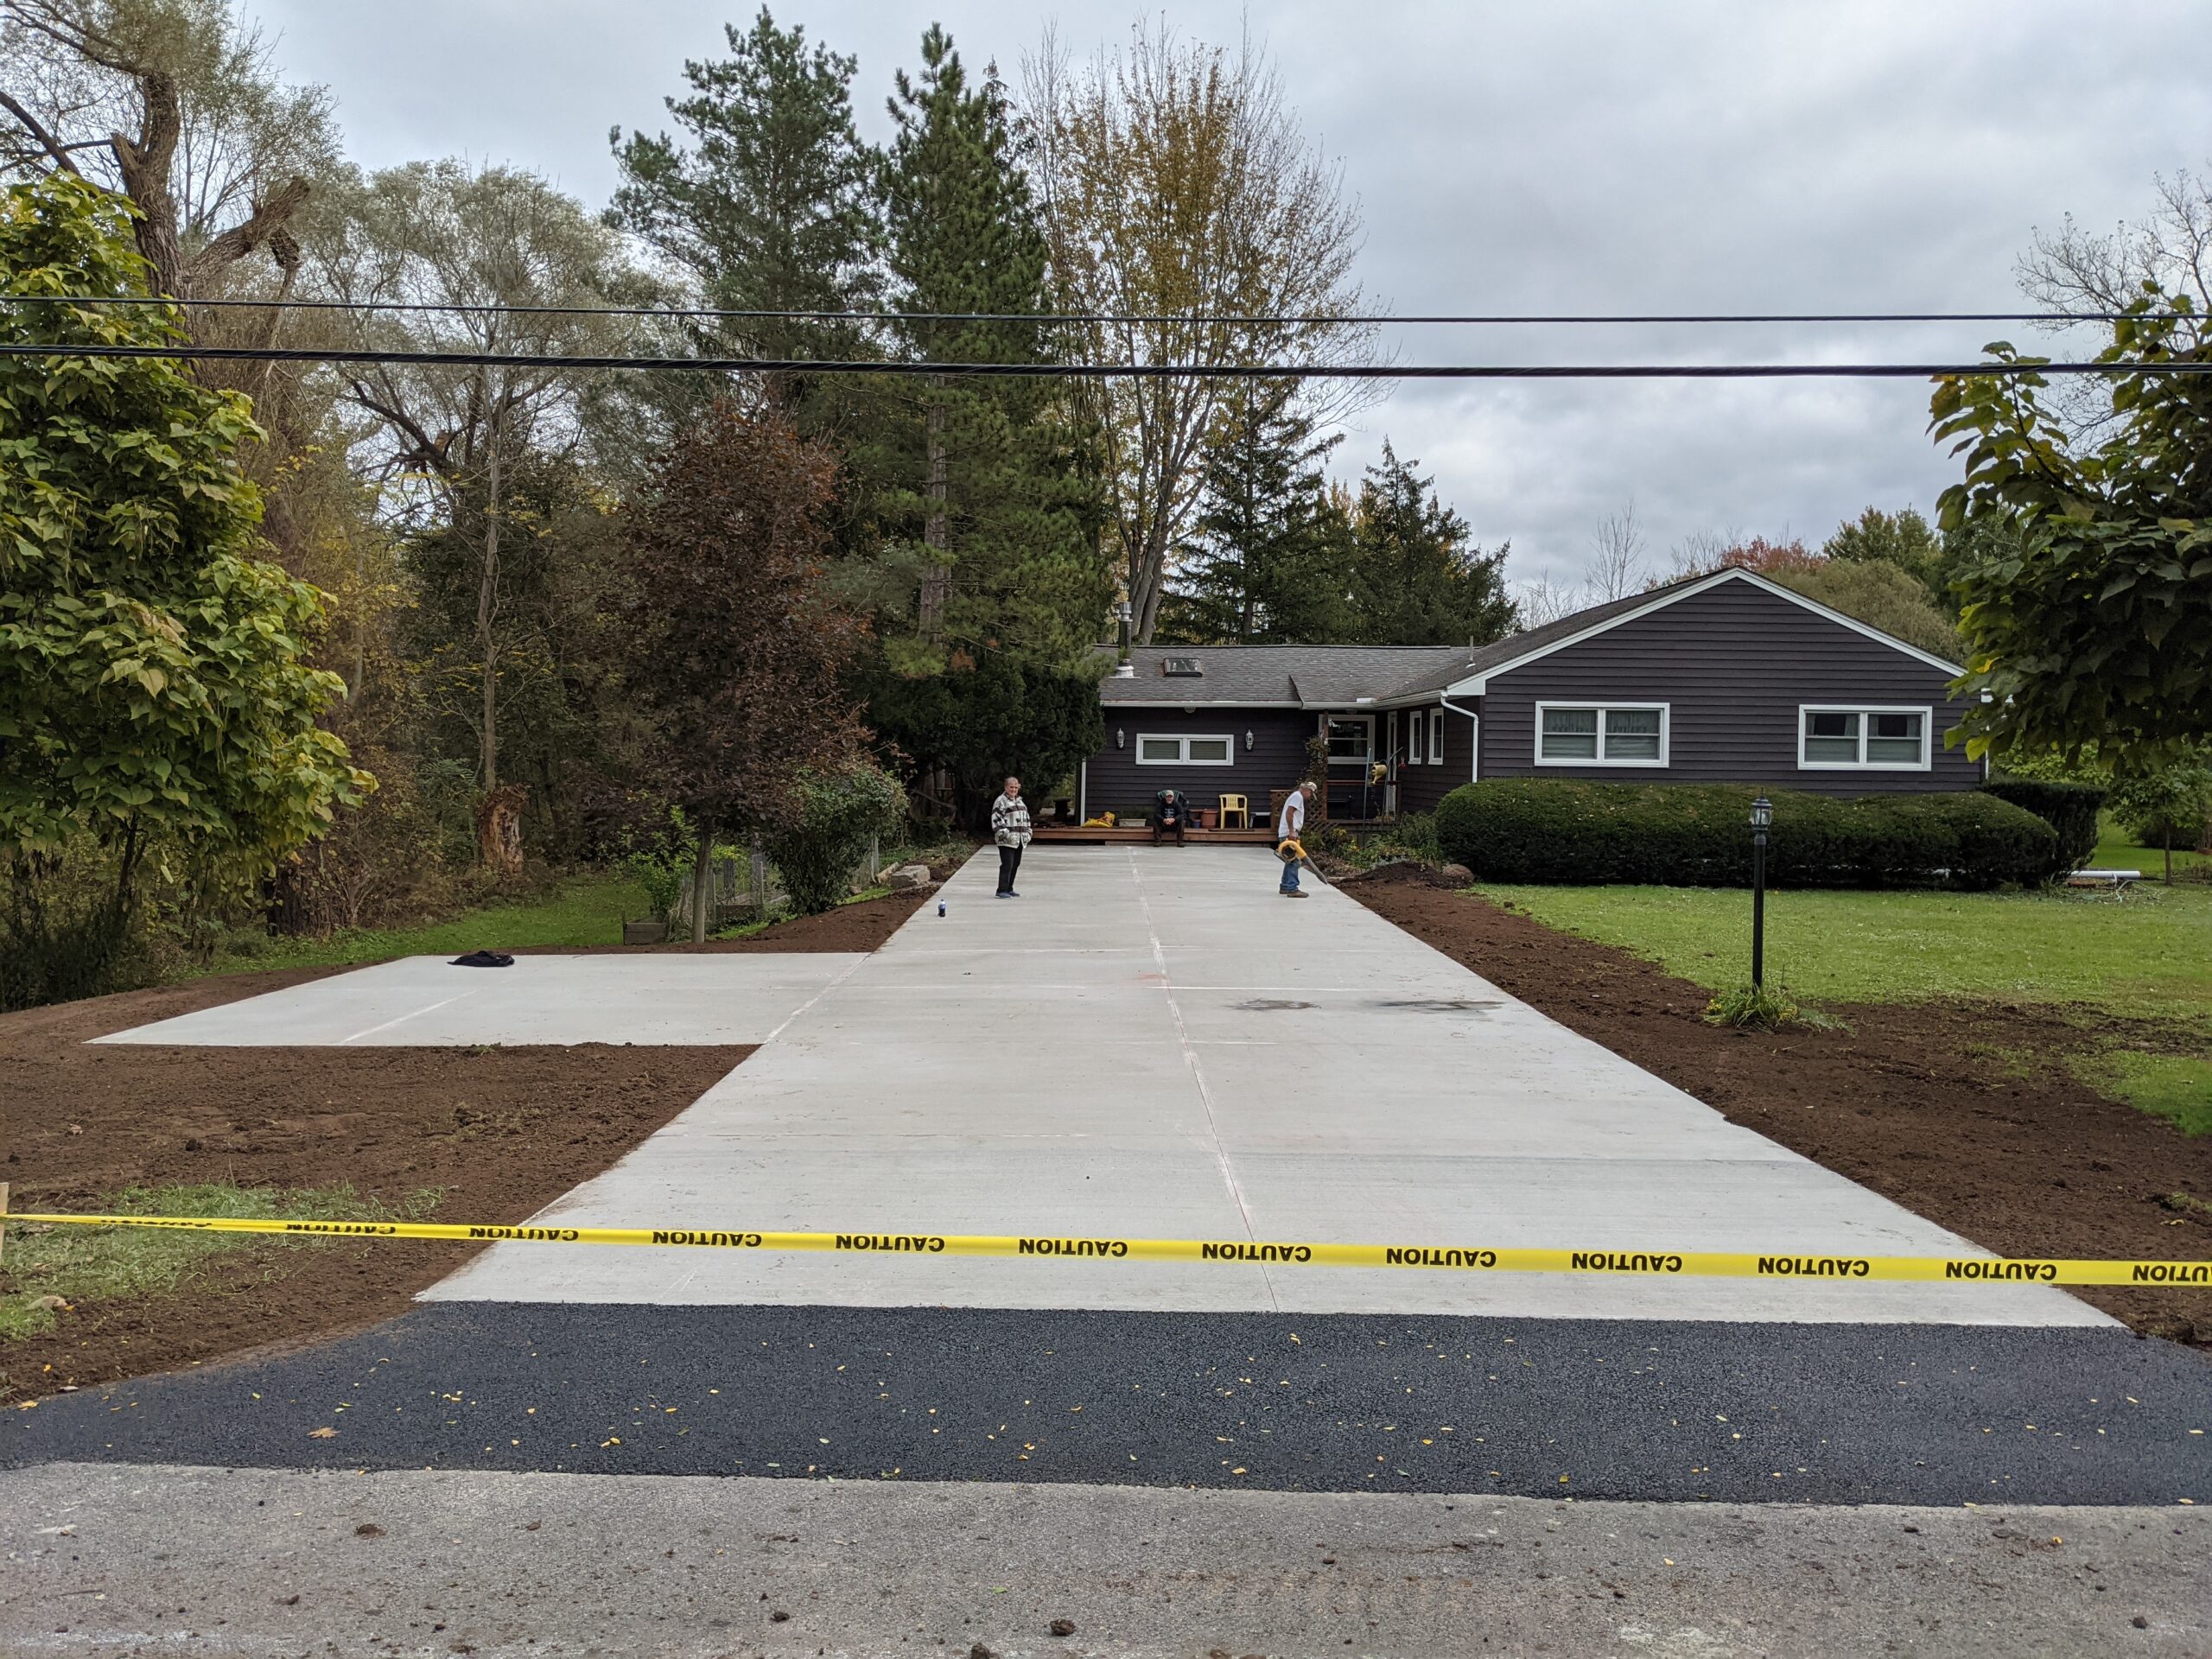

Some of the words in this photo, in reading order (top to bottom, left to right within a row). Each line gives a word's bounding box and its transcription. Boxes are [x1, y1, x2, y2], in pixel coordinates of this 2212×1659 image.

[469, 1228, 579, 1242] CAUTION
[652, 1232, 762, 1247] CAUTION
[836, 1236, 945, 1252] CAUTION
[1019, 1239, 1128, 1257] CAUTION
[1202, 1243, 1312, 1262] CAUTION
[1387, 1249, 1497, 1268] CAUTION
[1573, 1253, 1682, 1273] CAUTION
[1758, 1257, 1870, 1277] CAUTION
[1945, 1262, 2057, 1281] CAUTION
[2133, 1265, 2212, 1281] UTION
